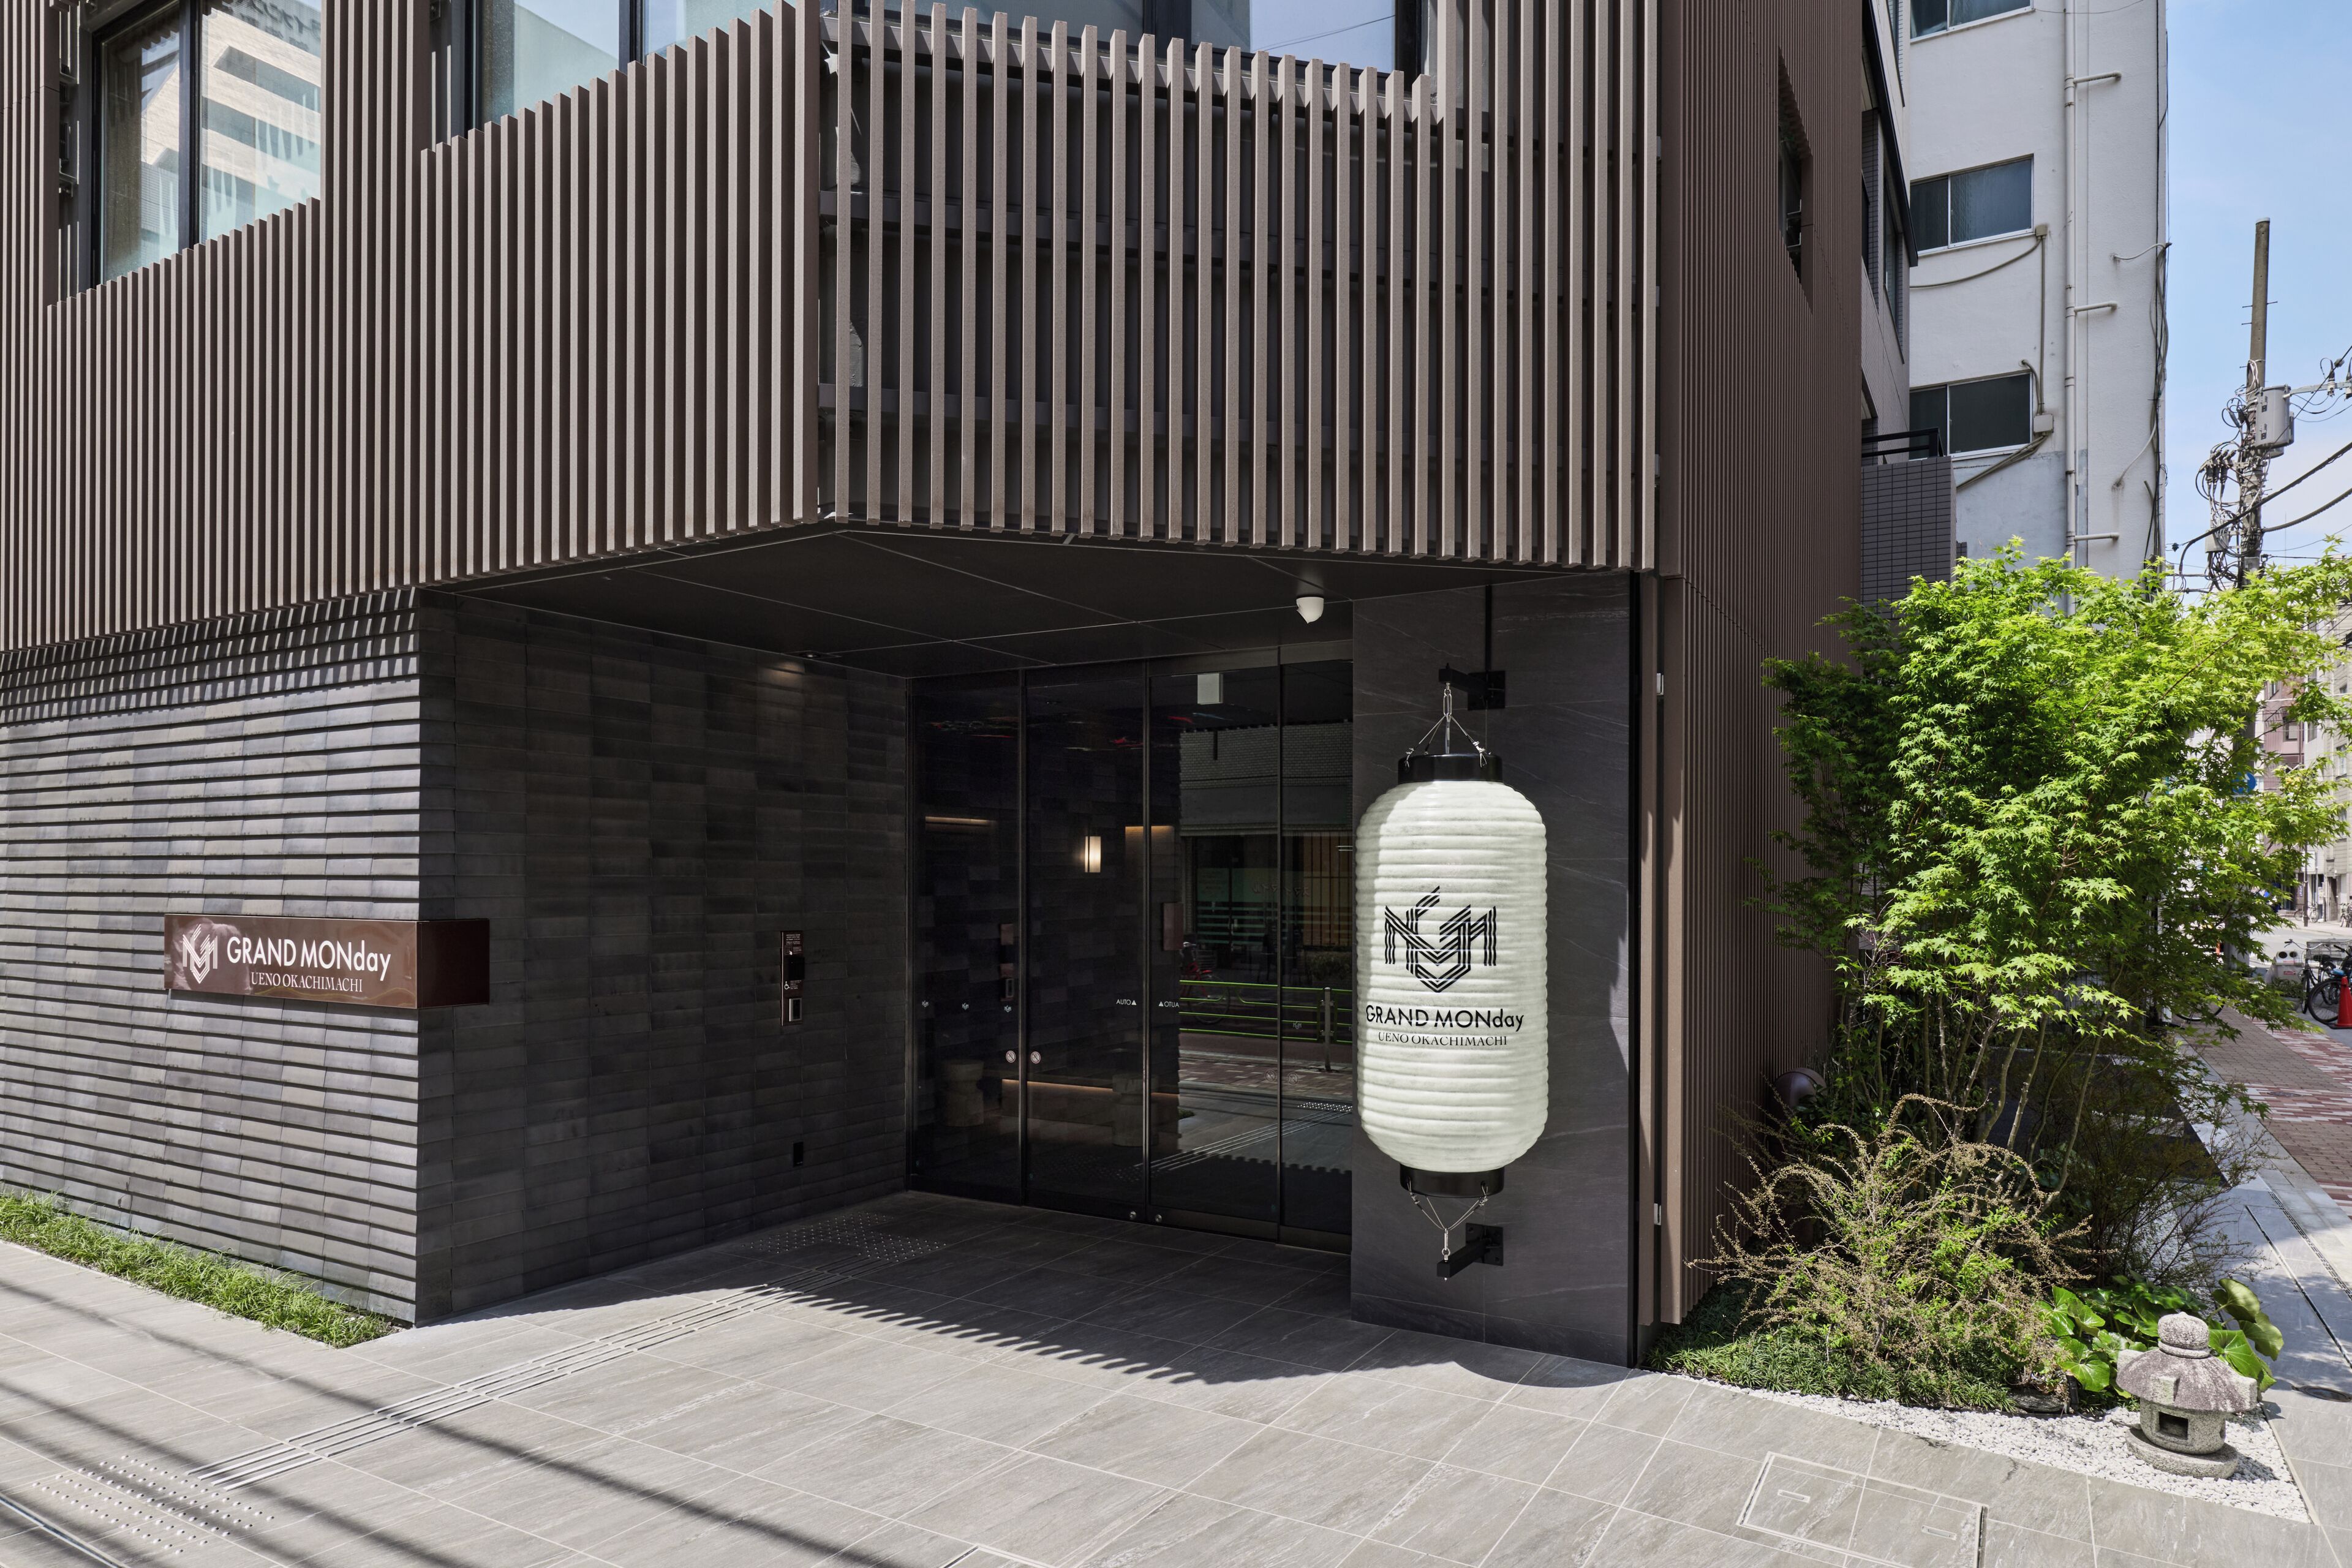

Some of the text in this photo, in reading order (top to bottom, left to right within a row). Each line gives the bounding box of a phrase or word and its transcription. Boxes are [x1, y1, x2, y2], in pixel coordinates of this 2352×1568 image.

[227, 936, 391, 981] GRAND MONday
[251, 971, 363, 992] UENO OKACHIMACHI
[1365, 1005, 1525, 1032] GRAND MONday
[1378, 1031, 1507, 1047] UENO OKACHIMACHI
